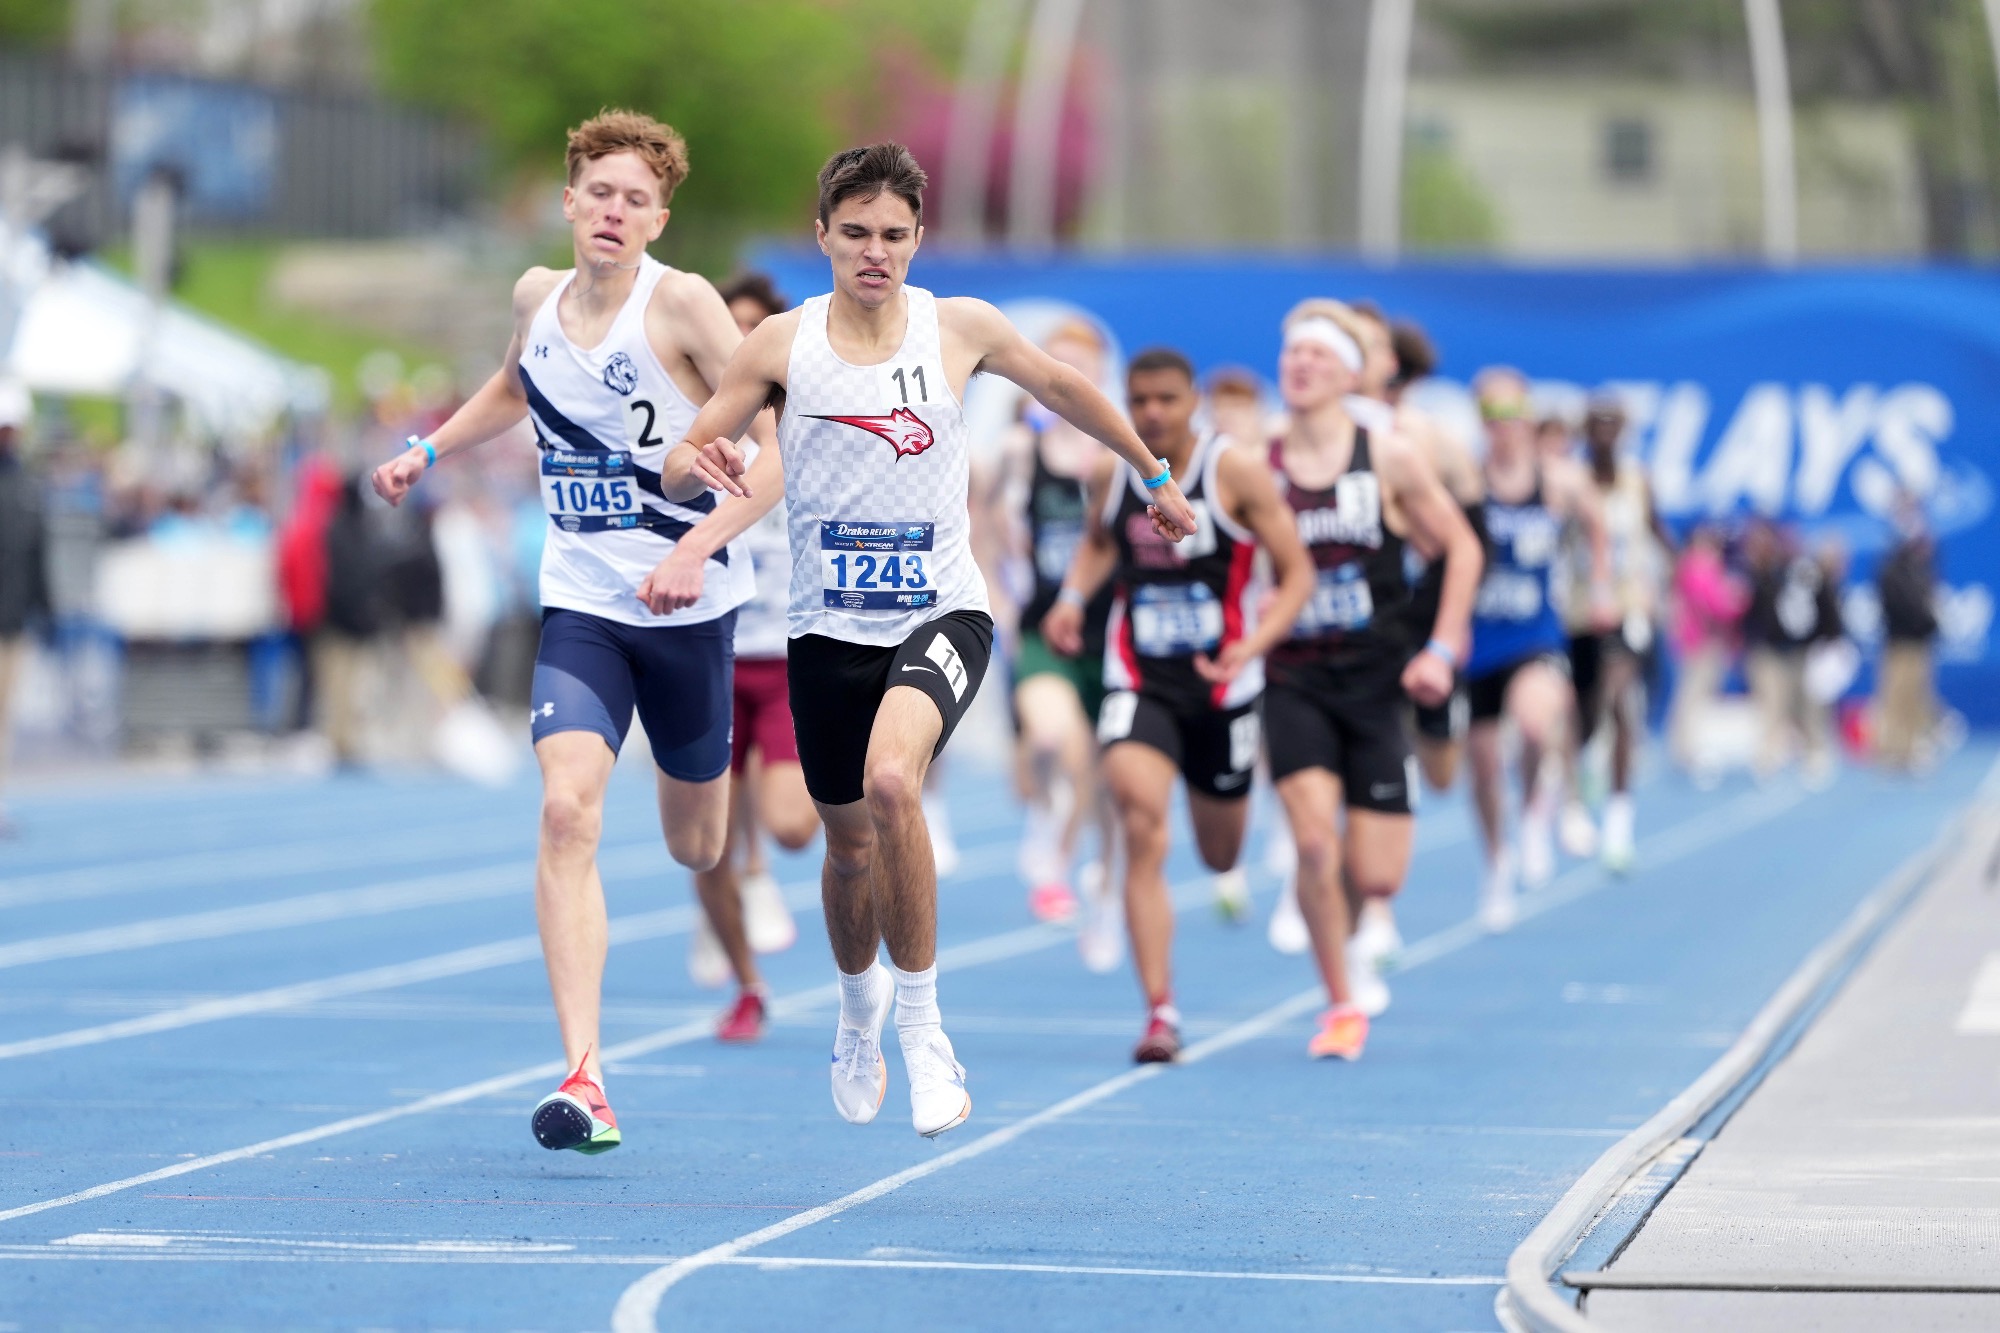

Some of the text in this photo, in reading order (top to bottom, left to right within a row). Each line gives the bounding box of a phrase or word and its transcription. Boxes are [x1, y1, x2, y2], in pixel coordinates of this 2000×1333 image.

[891, 365, 928, 404] 11
[631, 399, 664, 448] 2
[551, 480, 632, 512] 1045
[837, 523, 869, 536] Drake
[869, 528, 897, 536] RELAYS
[831, 553, 928, 589] 1243
[942, 648, 963, 687] 11
